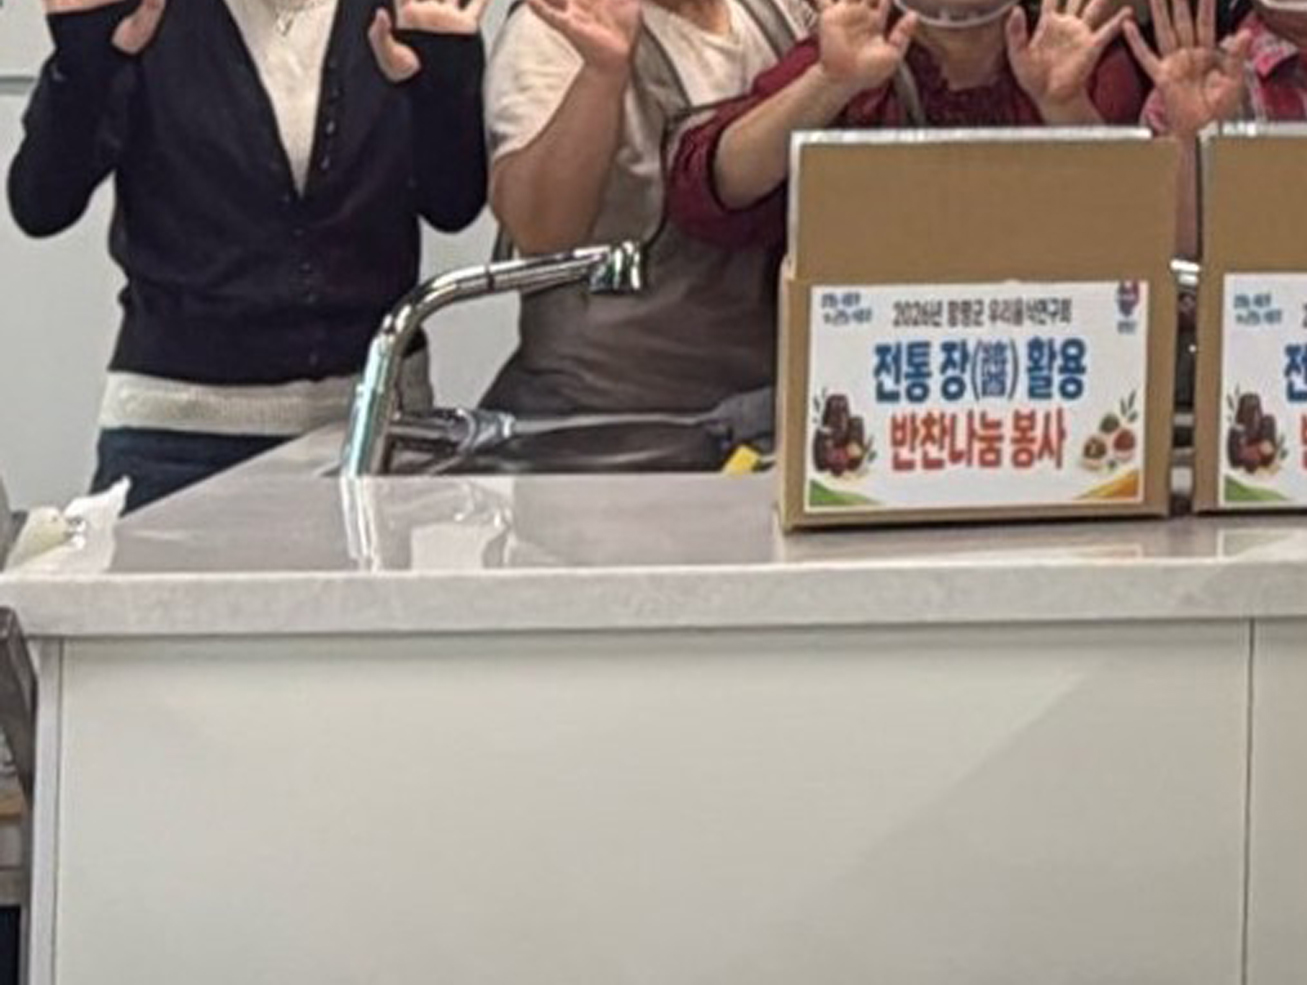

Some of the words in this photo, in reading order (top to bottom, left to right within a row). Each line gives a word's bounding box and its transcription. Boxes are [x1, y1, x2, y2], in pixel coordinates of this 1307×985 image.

[874, 341, 932, 403] 전통
[1027, 336, 1086, 400] 활용
[891, 410, 1003, 471] 반찬나눔
[1011, 408, 1066, 470] 봉사
